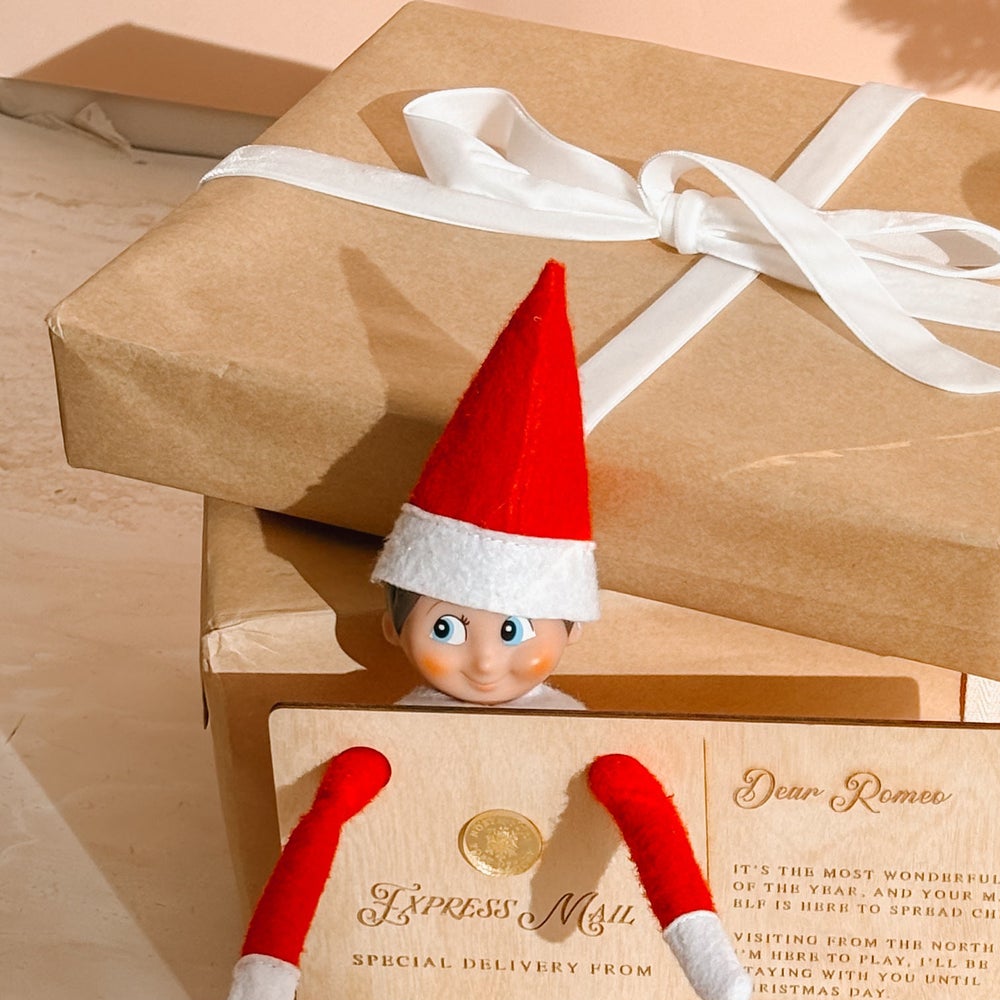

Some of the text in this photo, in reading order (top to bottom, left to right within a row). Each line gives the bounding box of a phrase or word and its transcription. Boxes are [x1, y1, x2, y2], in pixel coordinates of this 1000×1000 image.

[733, 767, 953, 813] Dear Romeo
[733, 863, 770, 876] IT'S
[777, 865, 814, 878] THE
[823, 868, 874, 881] MOST
[732, 881, 755, 892] OF
[763, 882, 800, 894] THE
[873, 887, 913, 899] AND
[921, 889, 972, 901] YOUR
[357, 882, 637, 937] EXPRESS MAIL
[733, 898, 766, 910] ELF
[775, 900, 791, 911] IS
[800, 901, 849, 913] HERE
[857, 903, 881, 914] TO
[889, 905, 963, 918] SPREAD
[733, 932, 818, 946] VISITING
[827, 936, 878, 948] FROM
[885, 938, 922, 950] THE
[931, 941, 994, 954] NORTH
[352, 954, 652, 977] SPECIAL DELIVERY FROM
[771, 950, 819, 963] HERE
[826, 952, 851, 964] TO
[920, 957, 957, 969] I'LL
[965, 959, 988, 970] BE
[743, 966, 981, 986] TAYING WITH YOU UNTIL
[752, 983, 840, 997] RISTMAS
